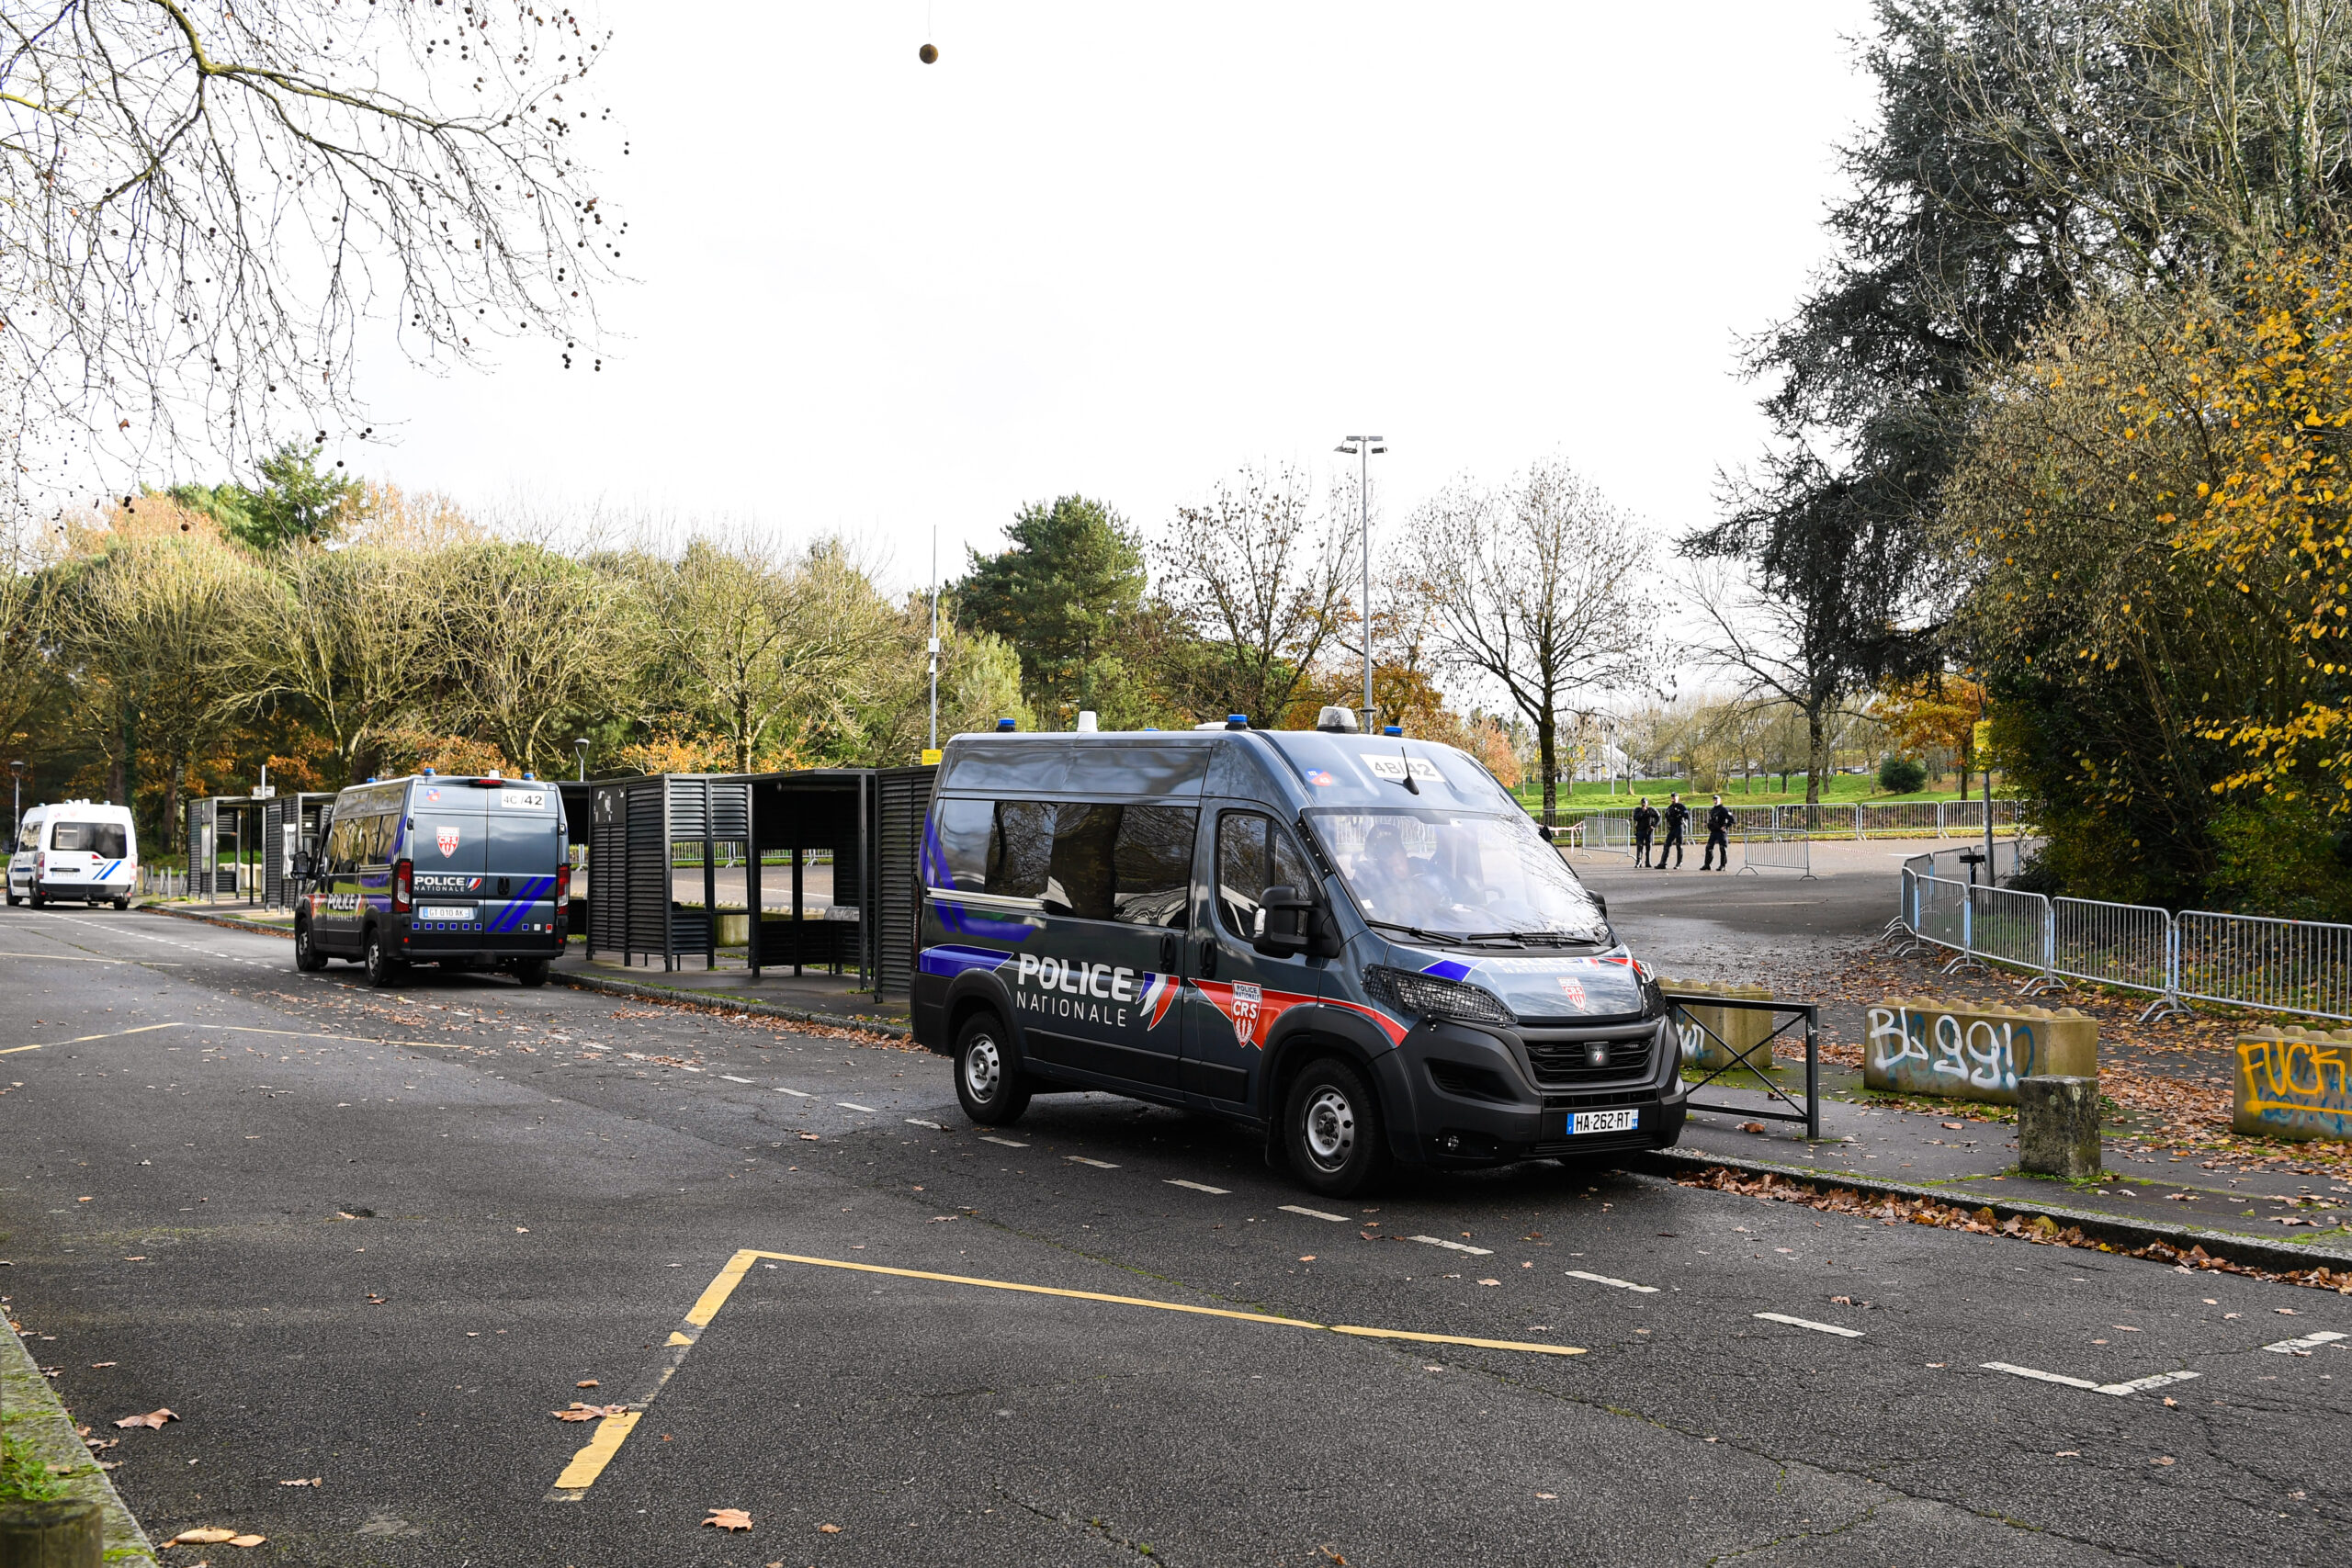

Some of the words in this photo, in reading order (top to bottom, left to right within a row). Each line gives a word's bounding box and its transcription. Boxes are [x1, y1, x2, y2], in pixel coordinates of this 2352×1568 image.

[438, 836, 458, 845] CRS
[413, 876, 466, 886] POLICE
[327, 893, 356, 910] POLICE
[1017, 953, 1135, 1002] POLICE
[1237, 985, 1257, 994] POLICE
[1565, 987, 1583, 995] CRS
[1236, 992, 1260, 1001] NATIONALE
[1016, 991, 1127, 1027] NATIONALE
[1233, 1000, 1258, 1019] CRS
[2237, 1039, 2346, 1105] FUCK
